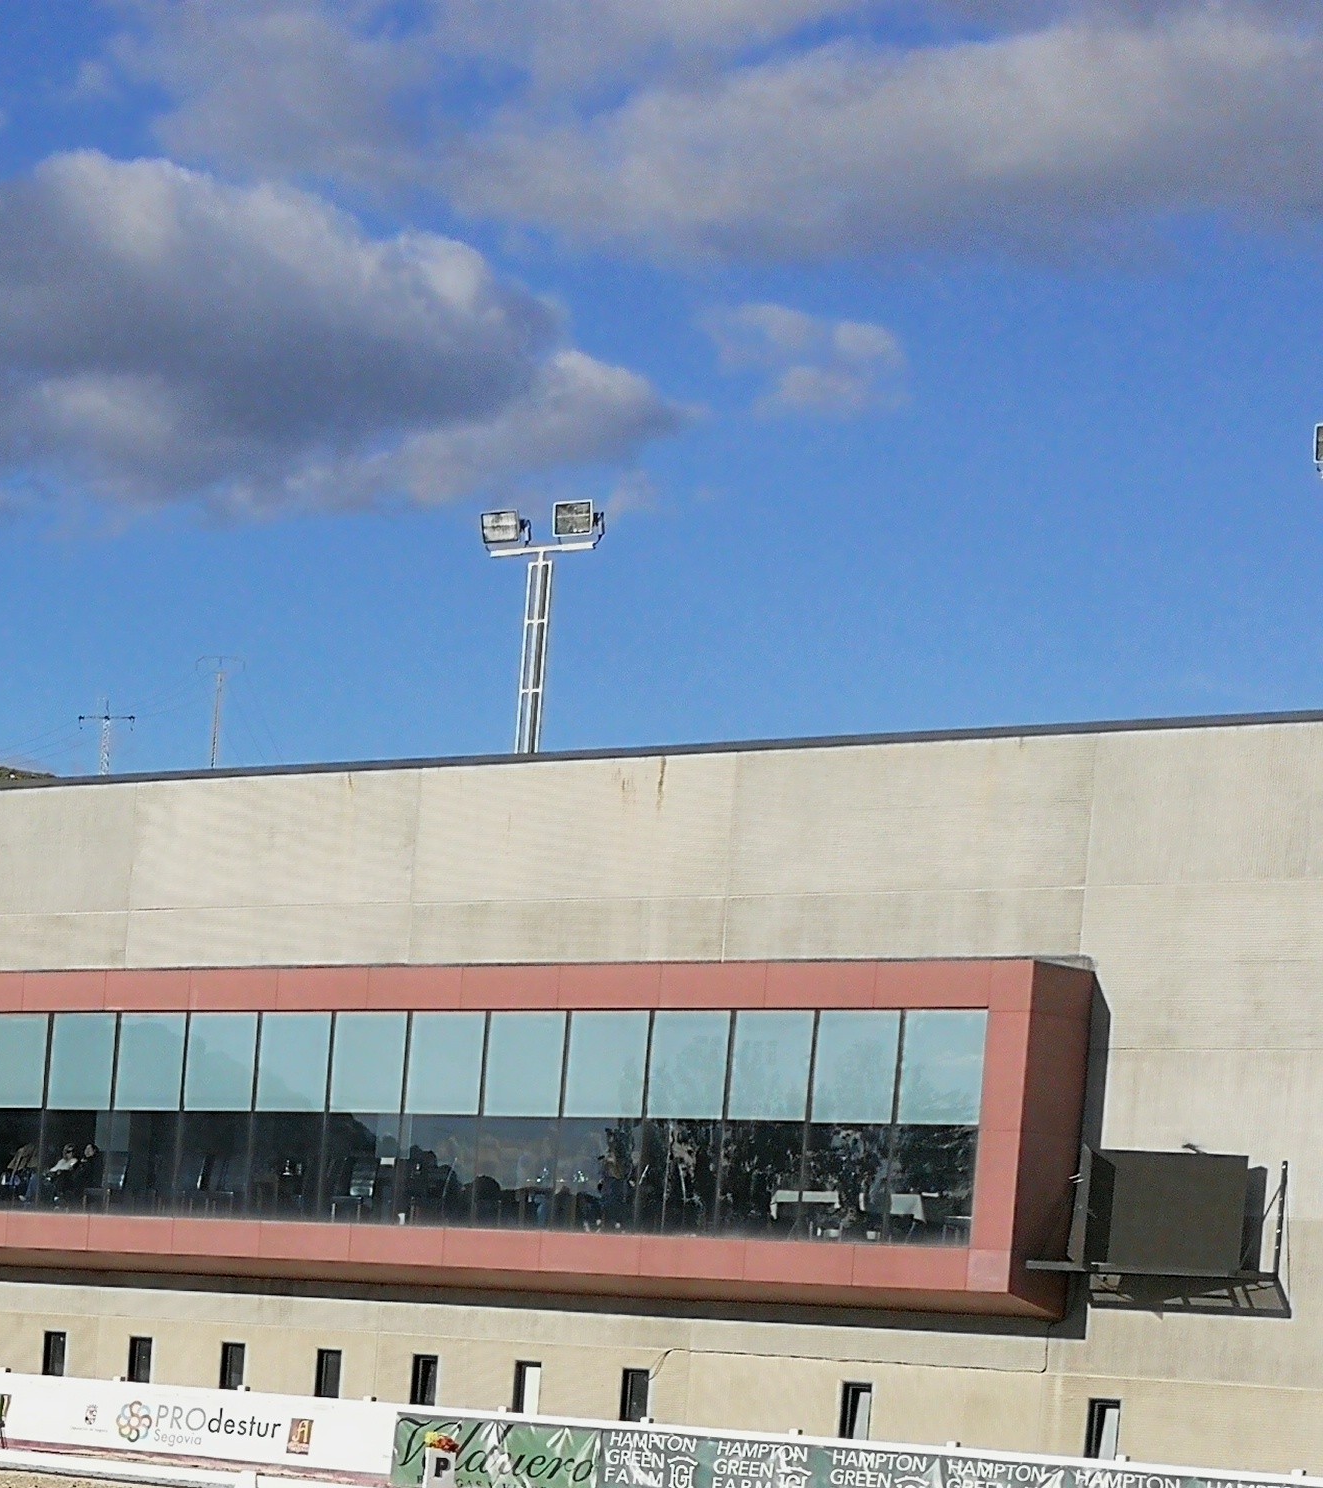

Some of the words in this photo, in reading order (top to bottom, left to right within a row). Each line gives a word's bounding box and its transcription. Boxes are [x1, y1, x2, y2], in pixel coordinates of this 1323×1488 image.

[153, 1431, 202, 1447] Segovia
[610, 1431, 697, 1453] HAMPTON
[607, 1449, 665, 1469] GREEN
[717, 1440, 808, 1462] HAMPTON
[832, 1449, 927, 1472] HAMPTON
[434, 1457, 450, 1478] P
[713, 1458, 774, 1478] GREEN
[947, 1458, 1046, 1483] HAMPTON
[830, 1469, 892, 1488] GREEN
